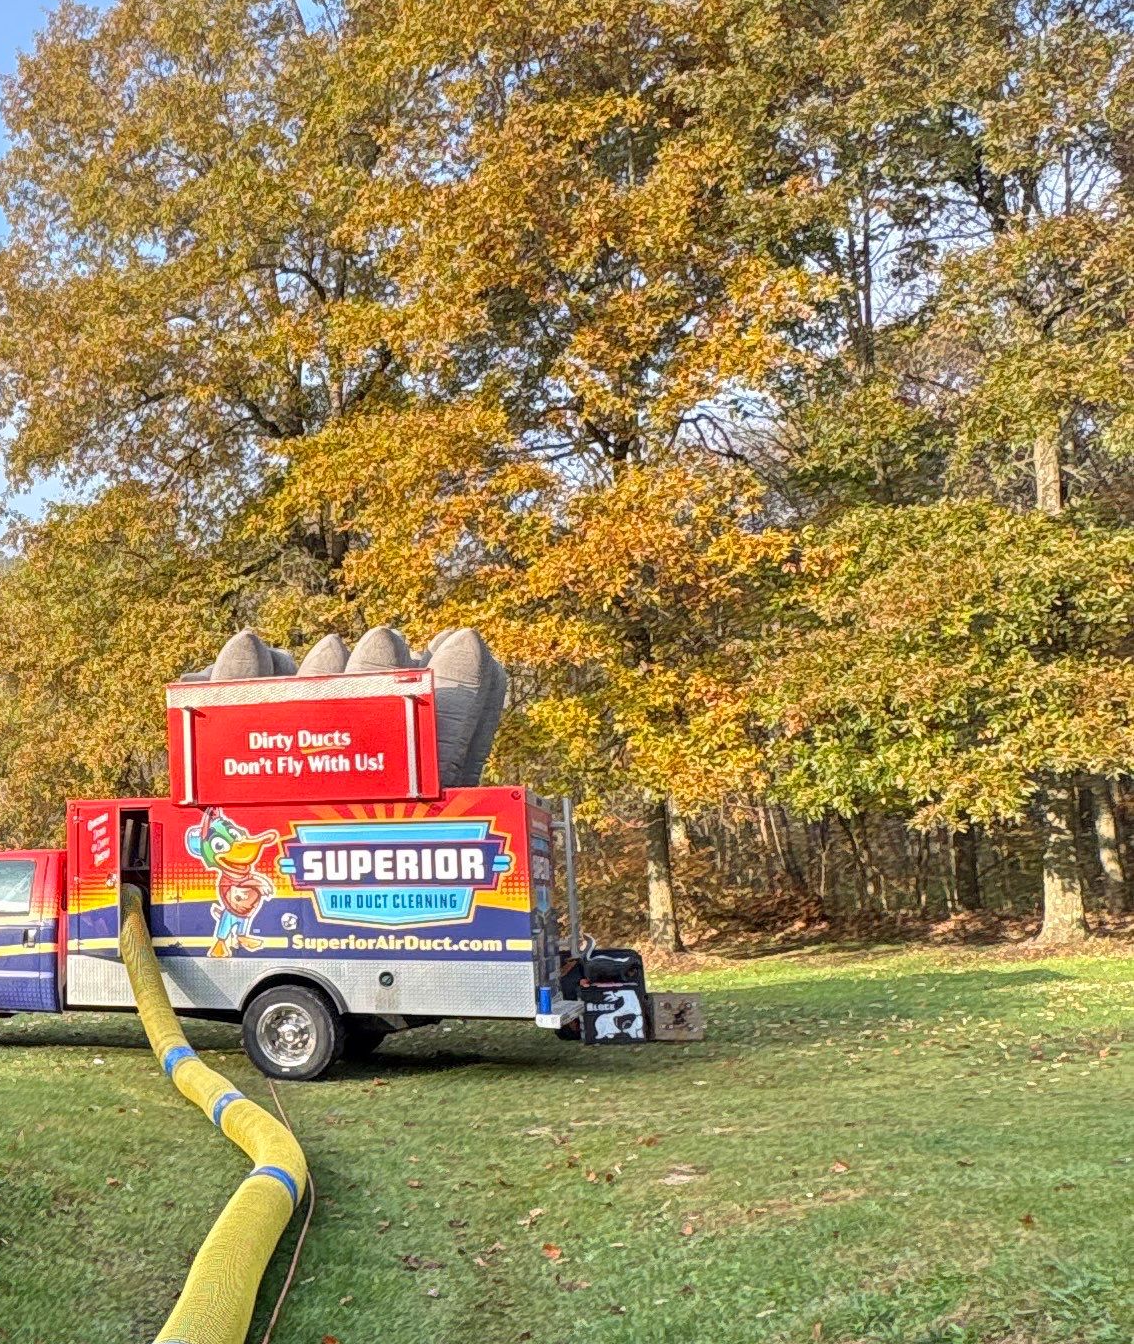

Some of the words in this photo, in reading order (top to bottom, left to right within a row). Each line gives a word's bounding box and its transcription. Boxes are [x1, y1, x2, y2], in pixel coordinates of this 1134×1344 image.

[249, 731, 293, 752] Dirty
[298, 730, 351, 748] Ducts
[224, 757, 273, 776] Don't
[277, 756, 303, 777] Fly
[307, 754, 350, 772] With
[355, 752, 384, 771] Us!
[302, 848, 485, 881] SUPERIOR
[330, 894, 352, 909] AIR
[356, 894, 388, 909] DUCT
[393, 893, 458, 909] CLEANING
[292, 934, 503, 952] SuperiorAirDuct.com
